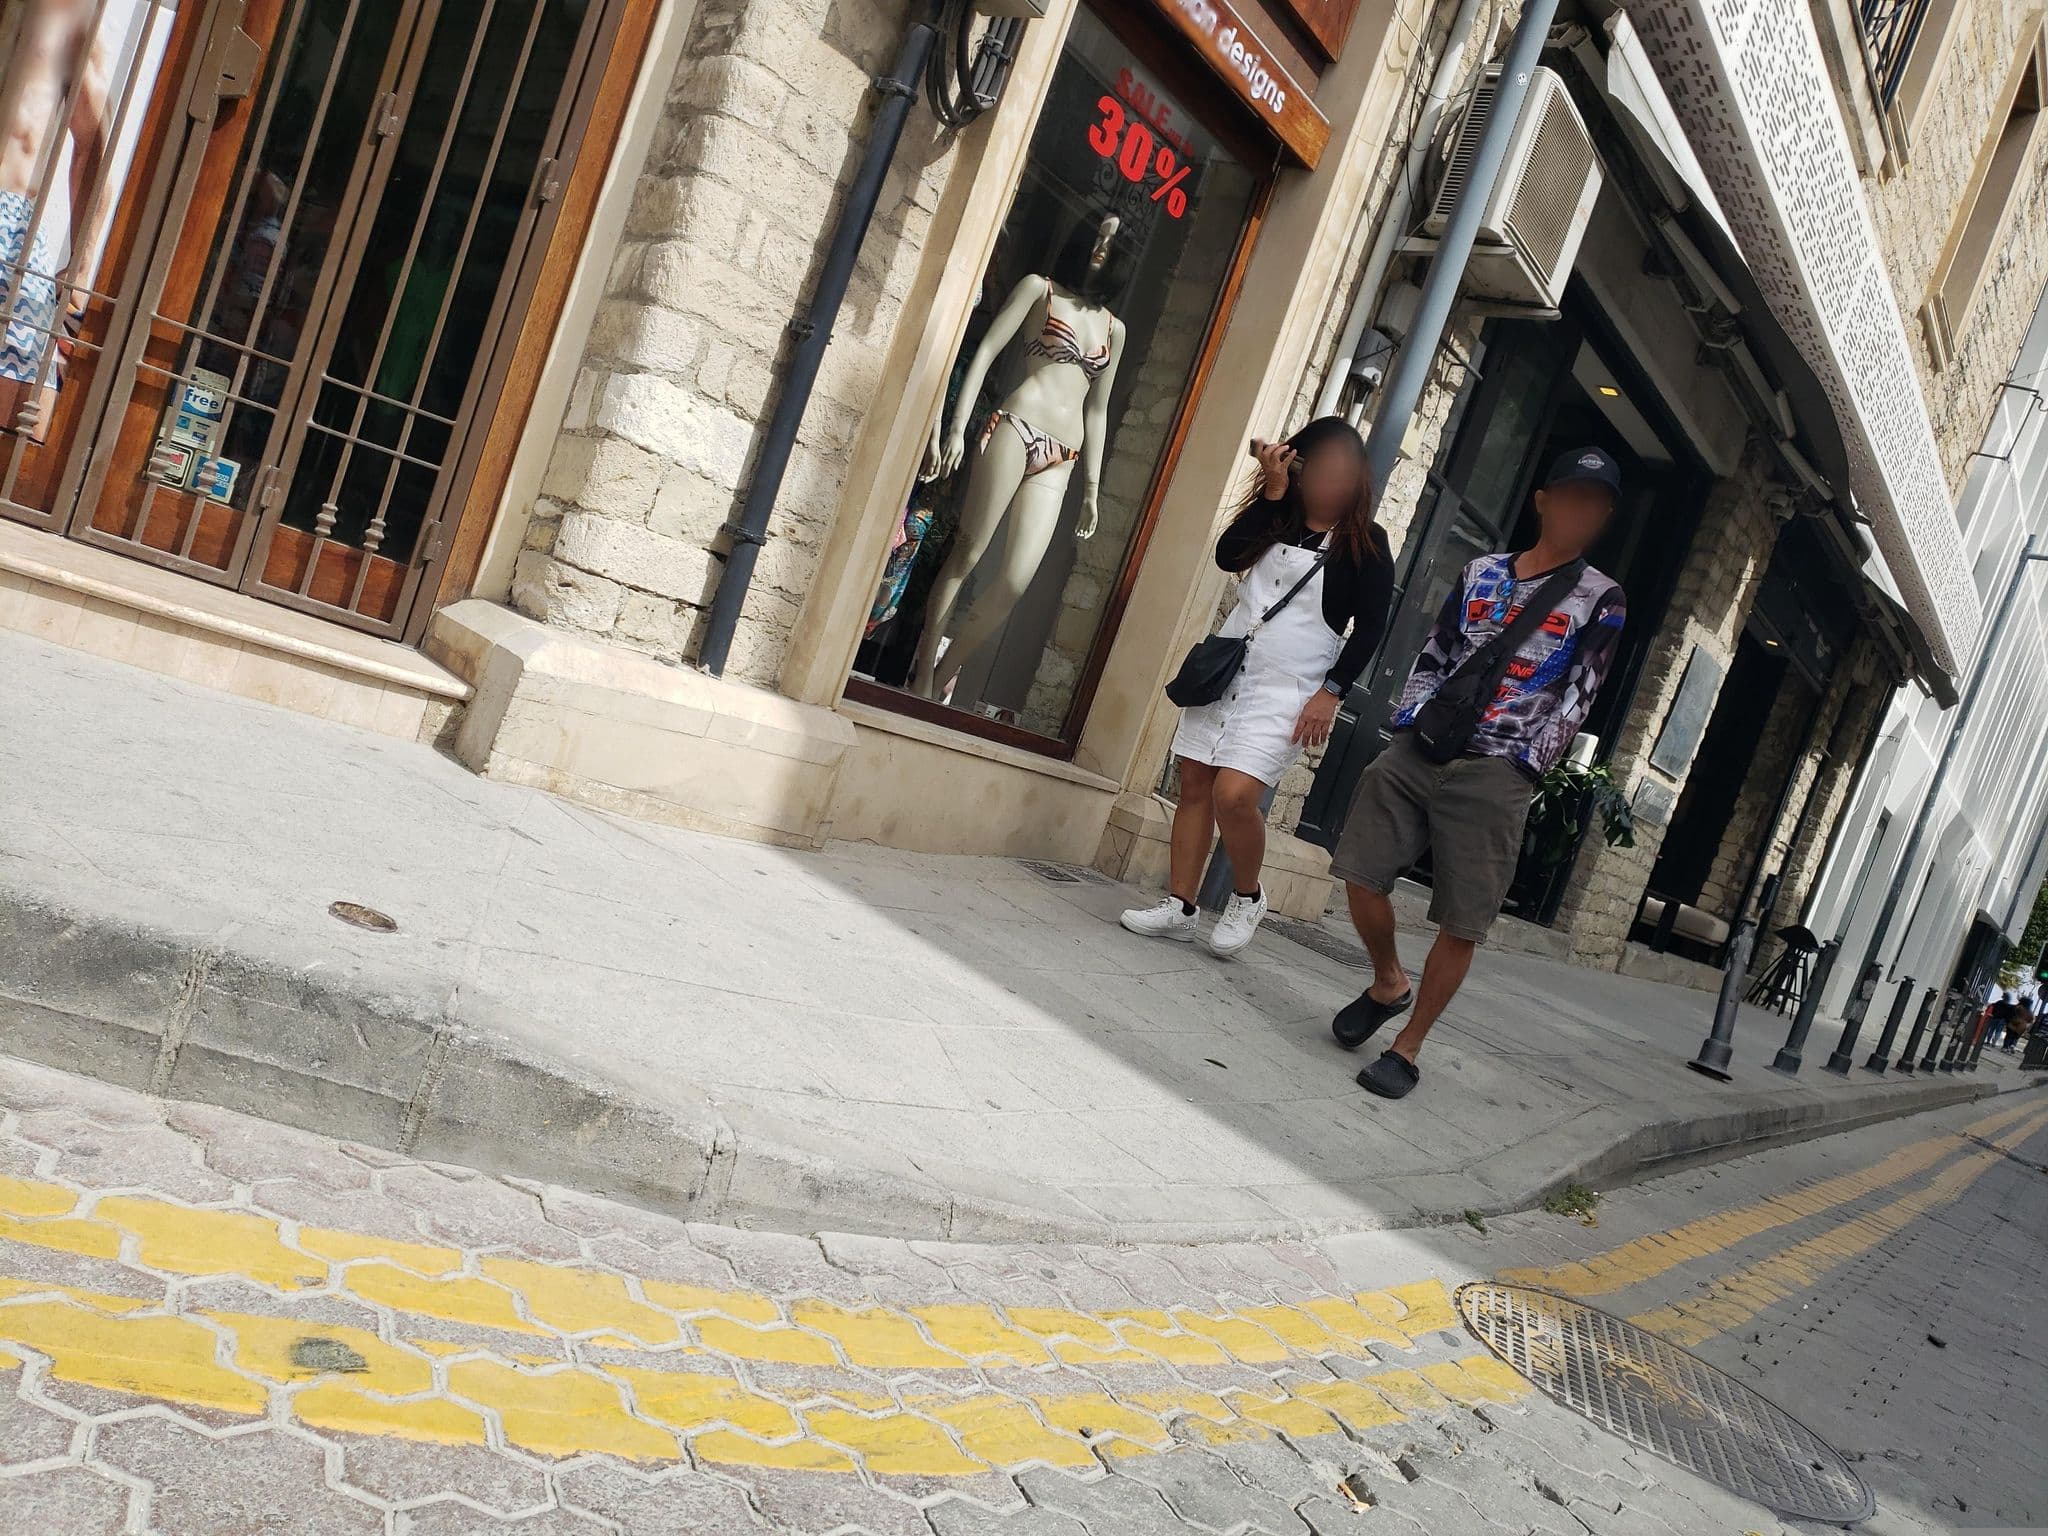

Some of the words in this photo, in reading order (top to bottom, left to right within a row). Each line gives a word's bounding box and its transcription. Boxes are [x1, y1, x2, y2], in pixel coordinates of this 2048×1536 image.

[1117, 68, 1172, 133] SALE
[1217, 26, 1286, 114] designs
[1088, 95, 1192, 219] 30%
[184, 388, 219, 410] free
